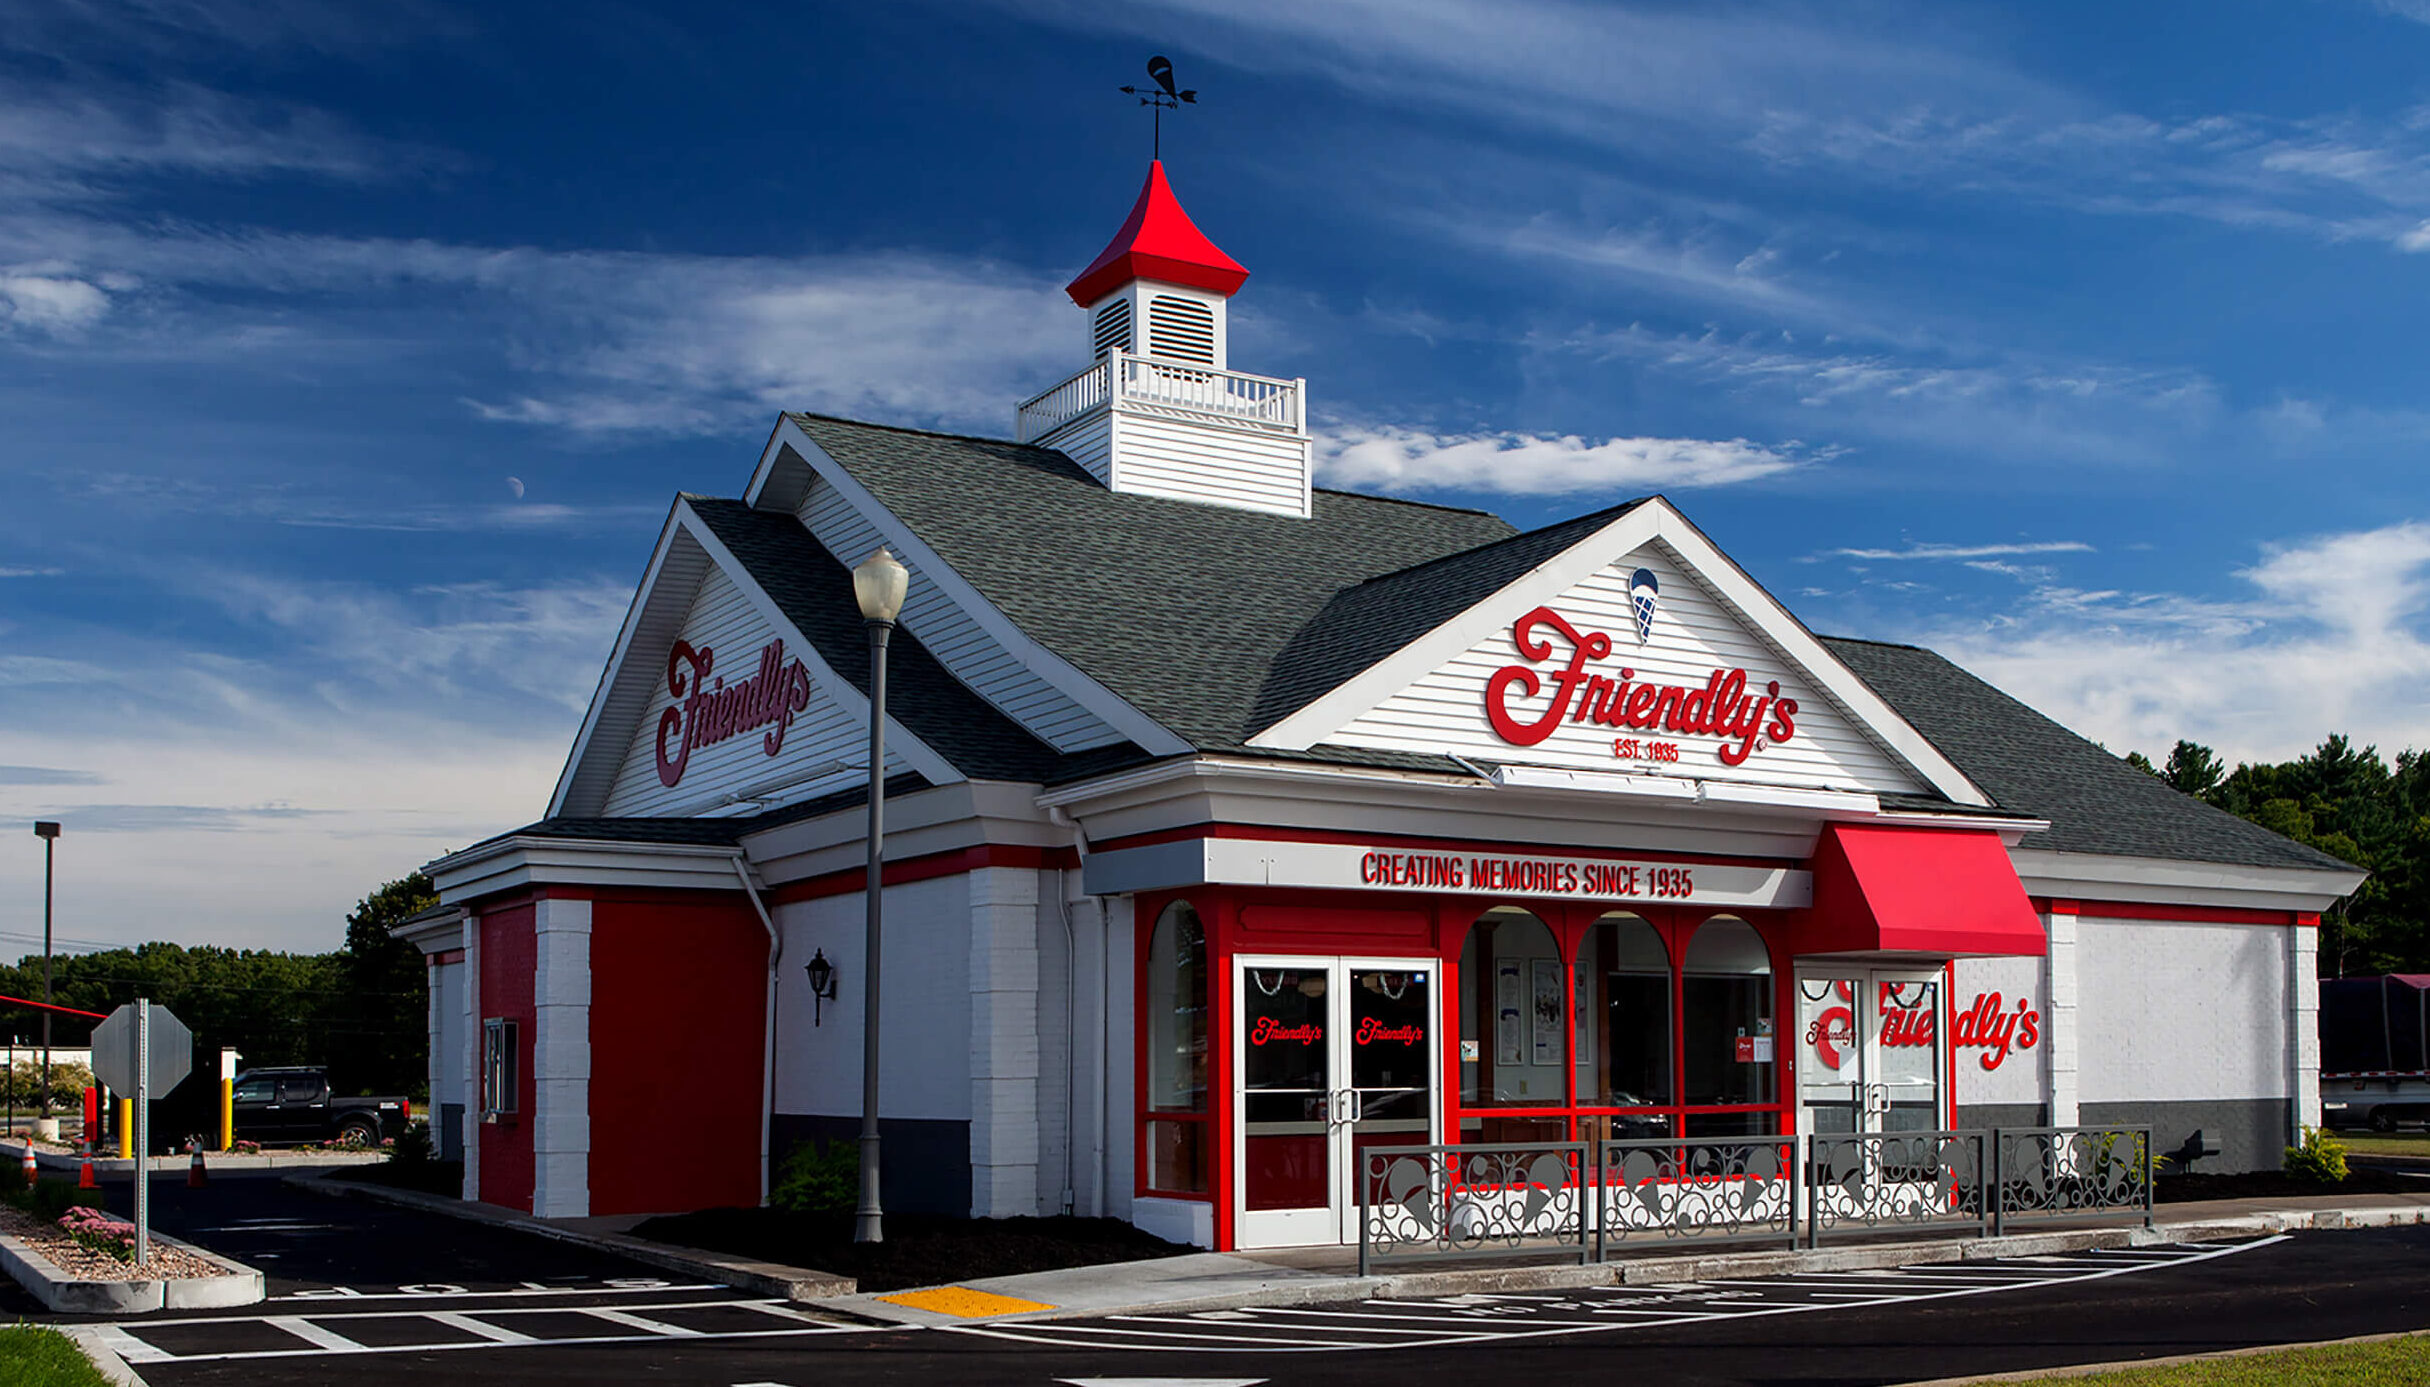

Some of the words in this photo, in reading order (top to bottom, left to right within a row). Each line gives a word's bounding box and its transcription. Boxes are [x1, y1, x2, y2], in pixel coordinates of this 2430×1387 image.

[1486, 606, 1799, 766] Friendly's
[656, 638, 809, 787] Friendly's
[1615, 738, 1641, 759] EST.
[1647, 741, 1678, 761] 1935
[1362, 851, 1465, 886] CREATING
[1470, 857, 1577, 892] MEMORIES
[1584, 863, 1640, 894] SINCE
[1648, 867, 1693, 897] 1935
[1251, 1016, 1322, 1045] Friendly's
[1355, 1016, 1423, 1046] Friendly's
[1816, 980, 2039, 1070] riedly's
